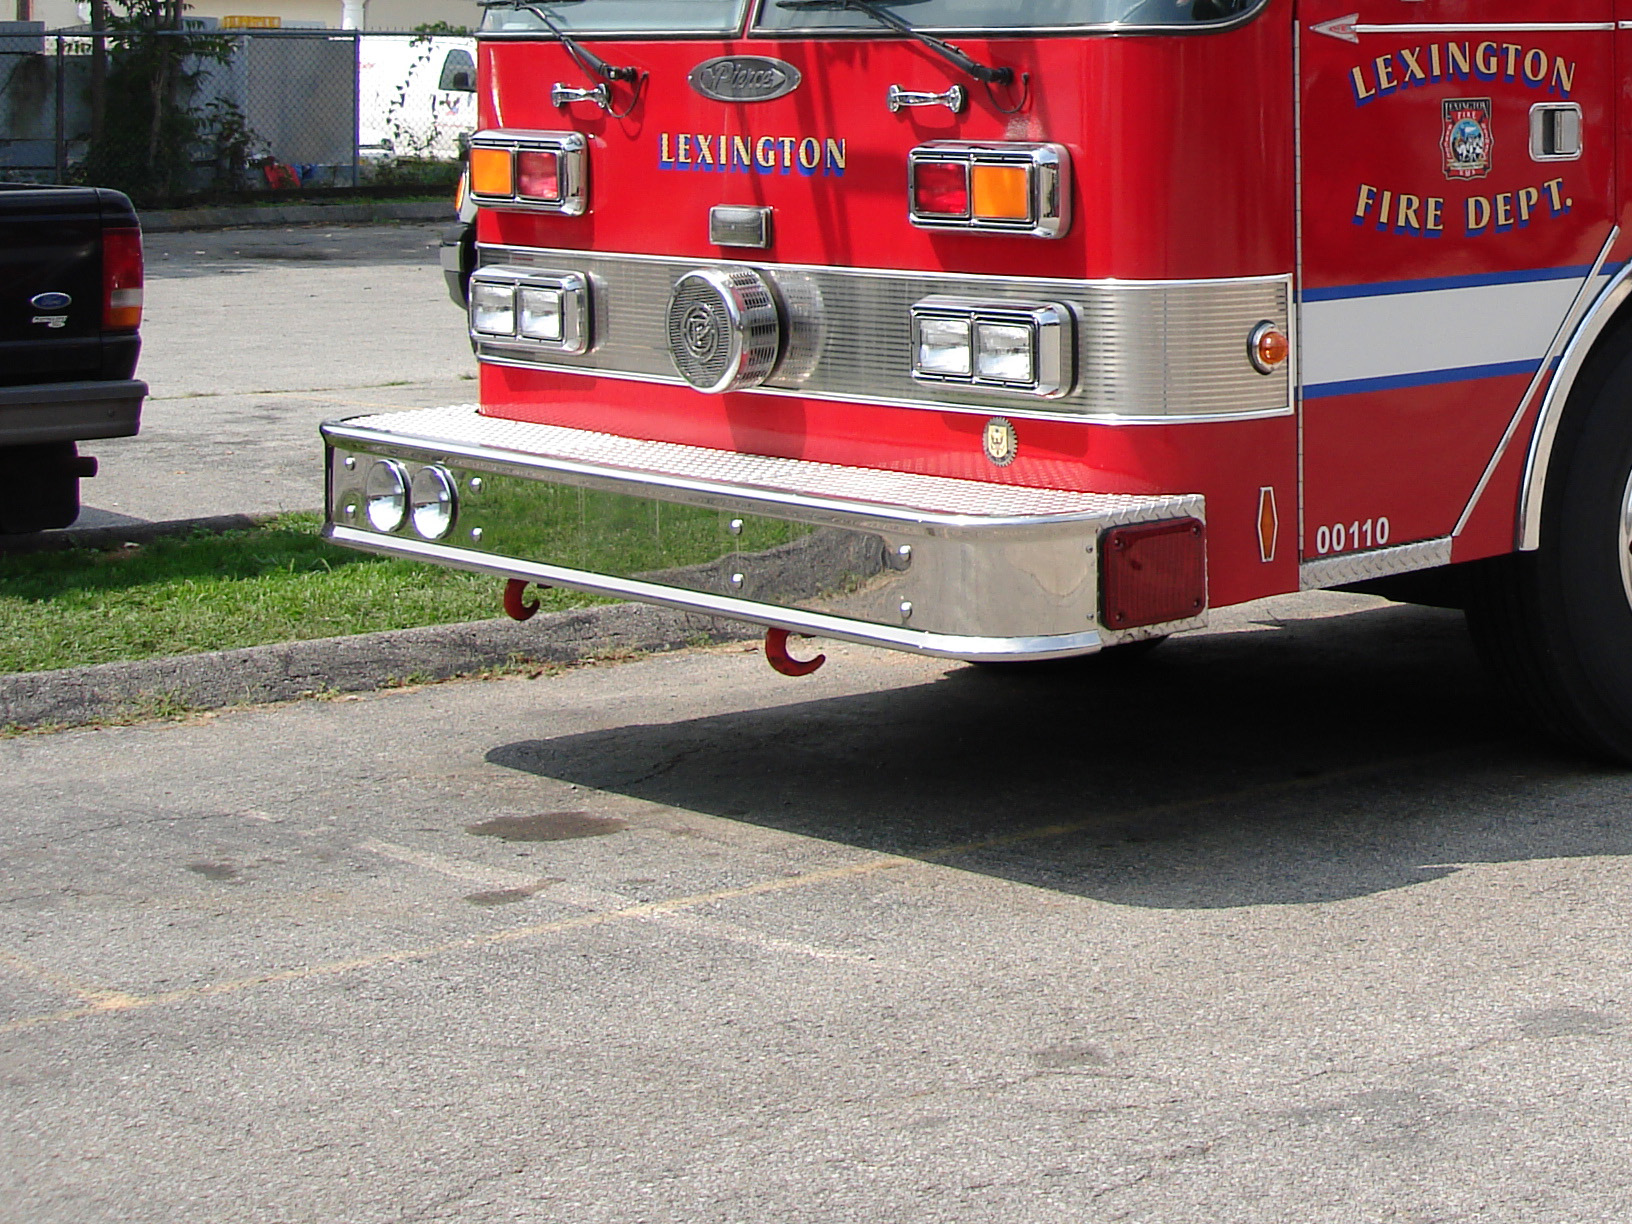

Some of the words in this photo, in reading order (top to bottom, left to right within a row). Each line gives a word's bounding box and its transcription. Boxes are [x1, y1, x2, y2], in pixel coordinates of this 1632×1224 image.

[711, 61, 774, 93] Pierce
[1350, 41, 1576, 103] LEXINGTON
[1445, 102, 1489, 121] LEXINGTON
[659, 132, 847, 175] LEXINGTON
[1353, 183, 1445, 235] FIRE
[1465, 177, 1573, 235] DEPT.
[1316, 516, 1390, 554] 00110
